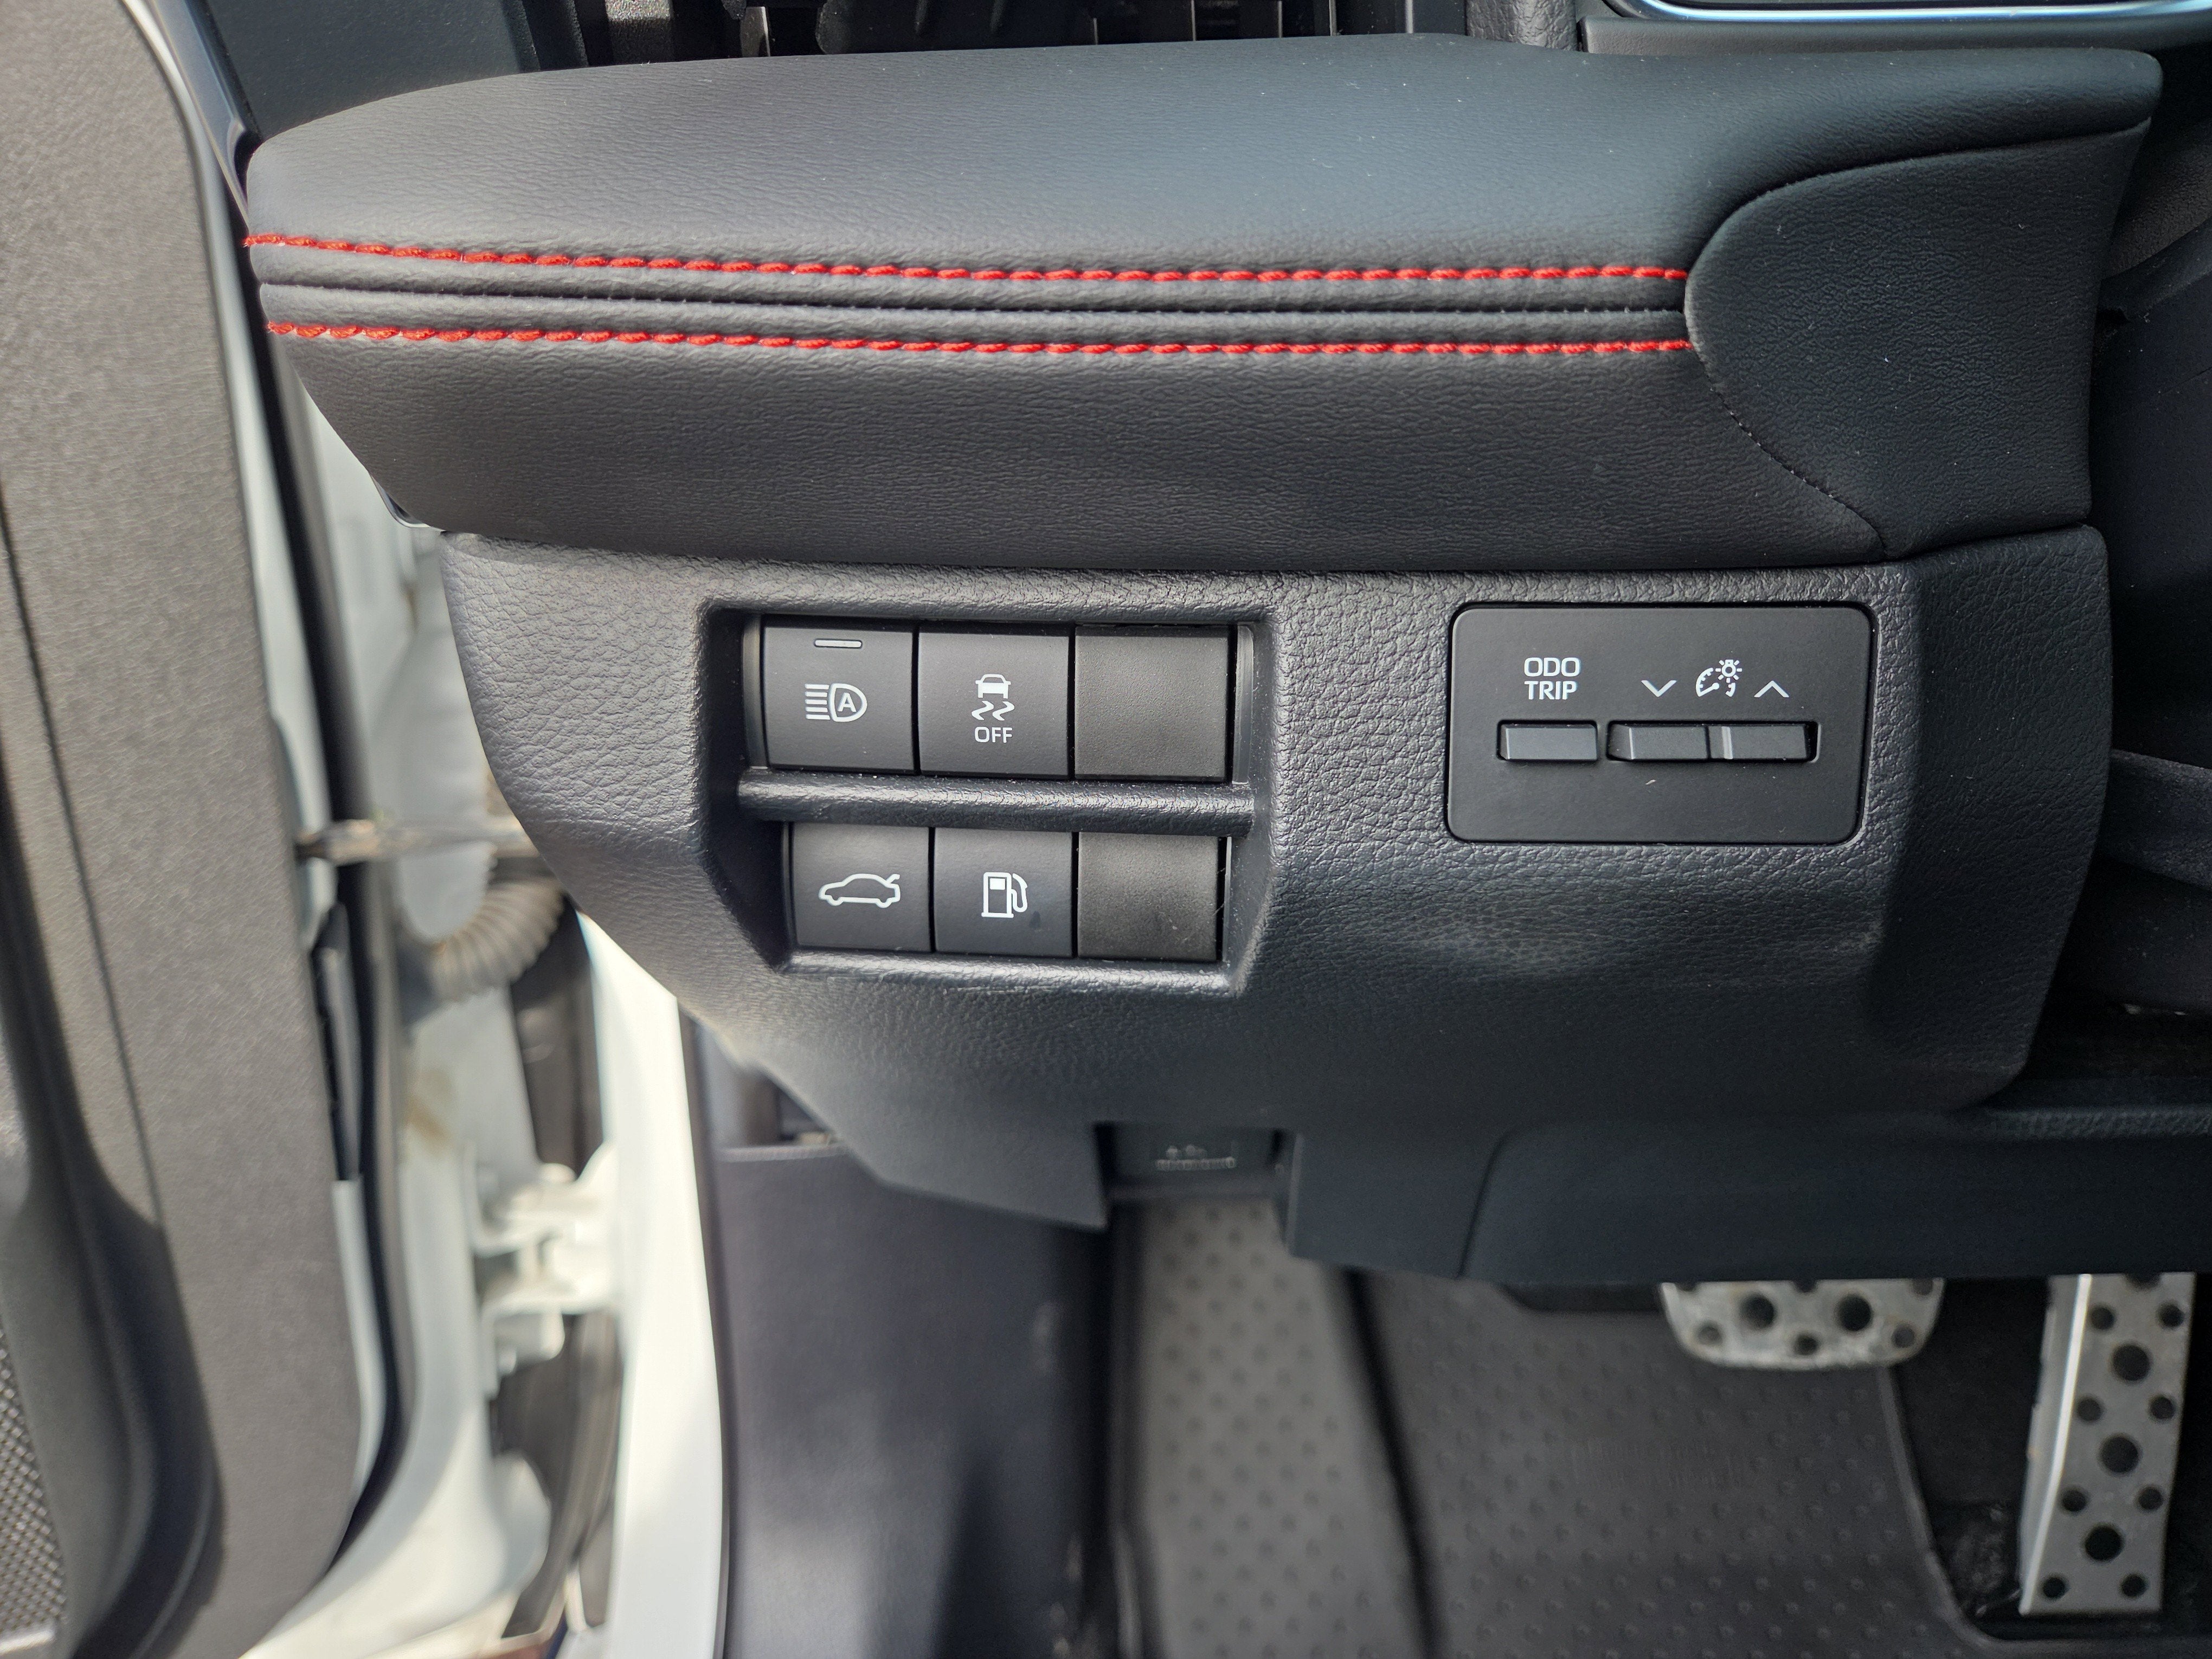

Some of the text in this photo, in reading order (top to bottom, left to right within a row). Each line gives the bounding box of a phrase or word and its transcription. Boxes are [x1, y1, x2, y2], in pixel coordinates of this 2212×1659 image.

[1524, 657, 1580, 677] ODO
[1524, 680, 1577, 700] TRIP
[838, 692, 857, 712] A
[974, 726, 1013, 743] OFF
